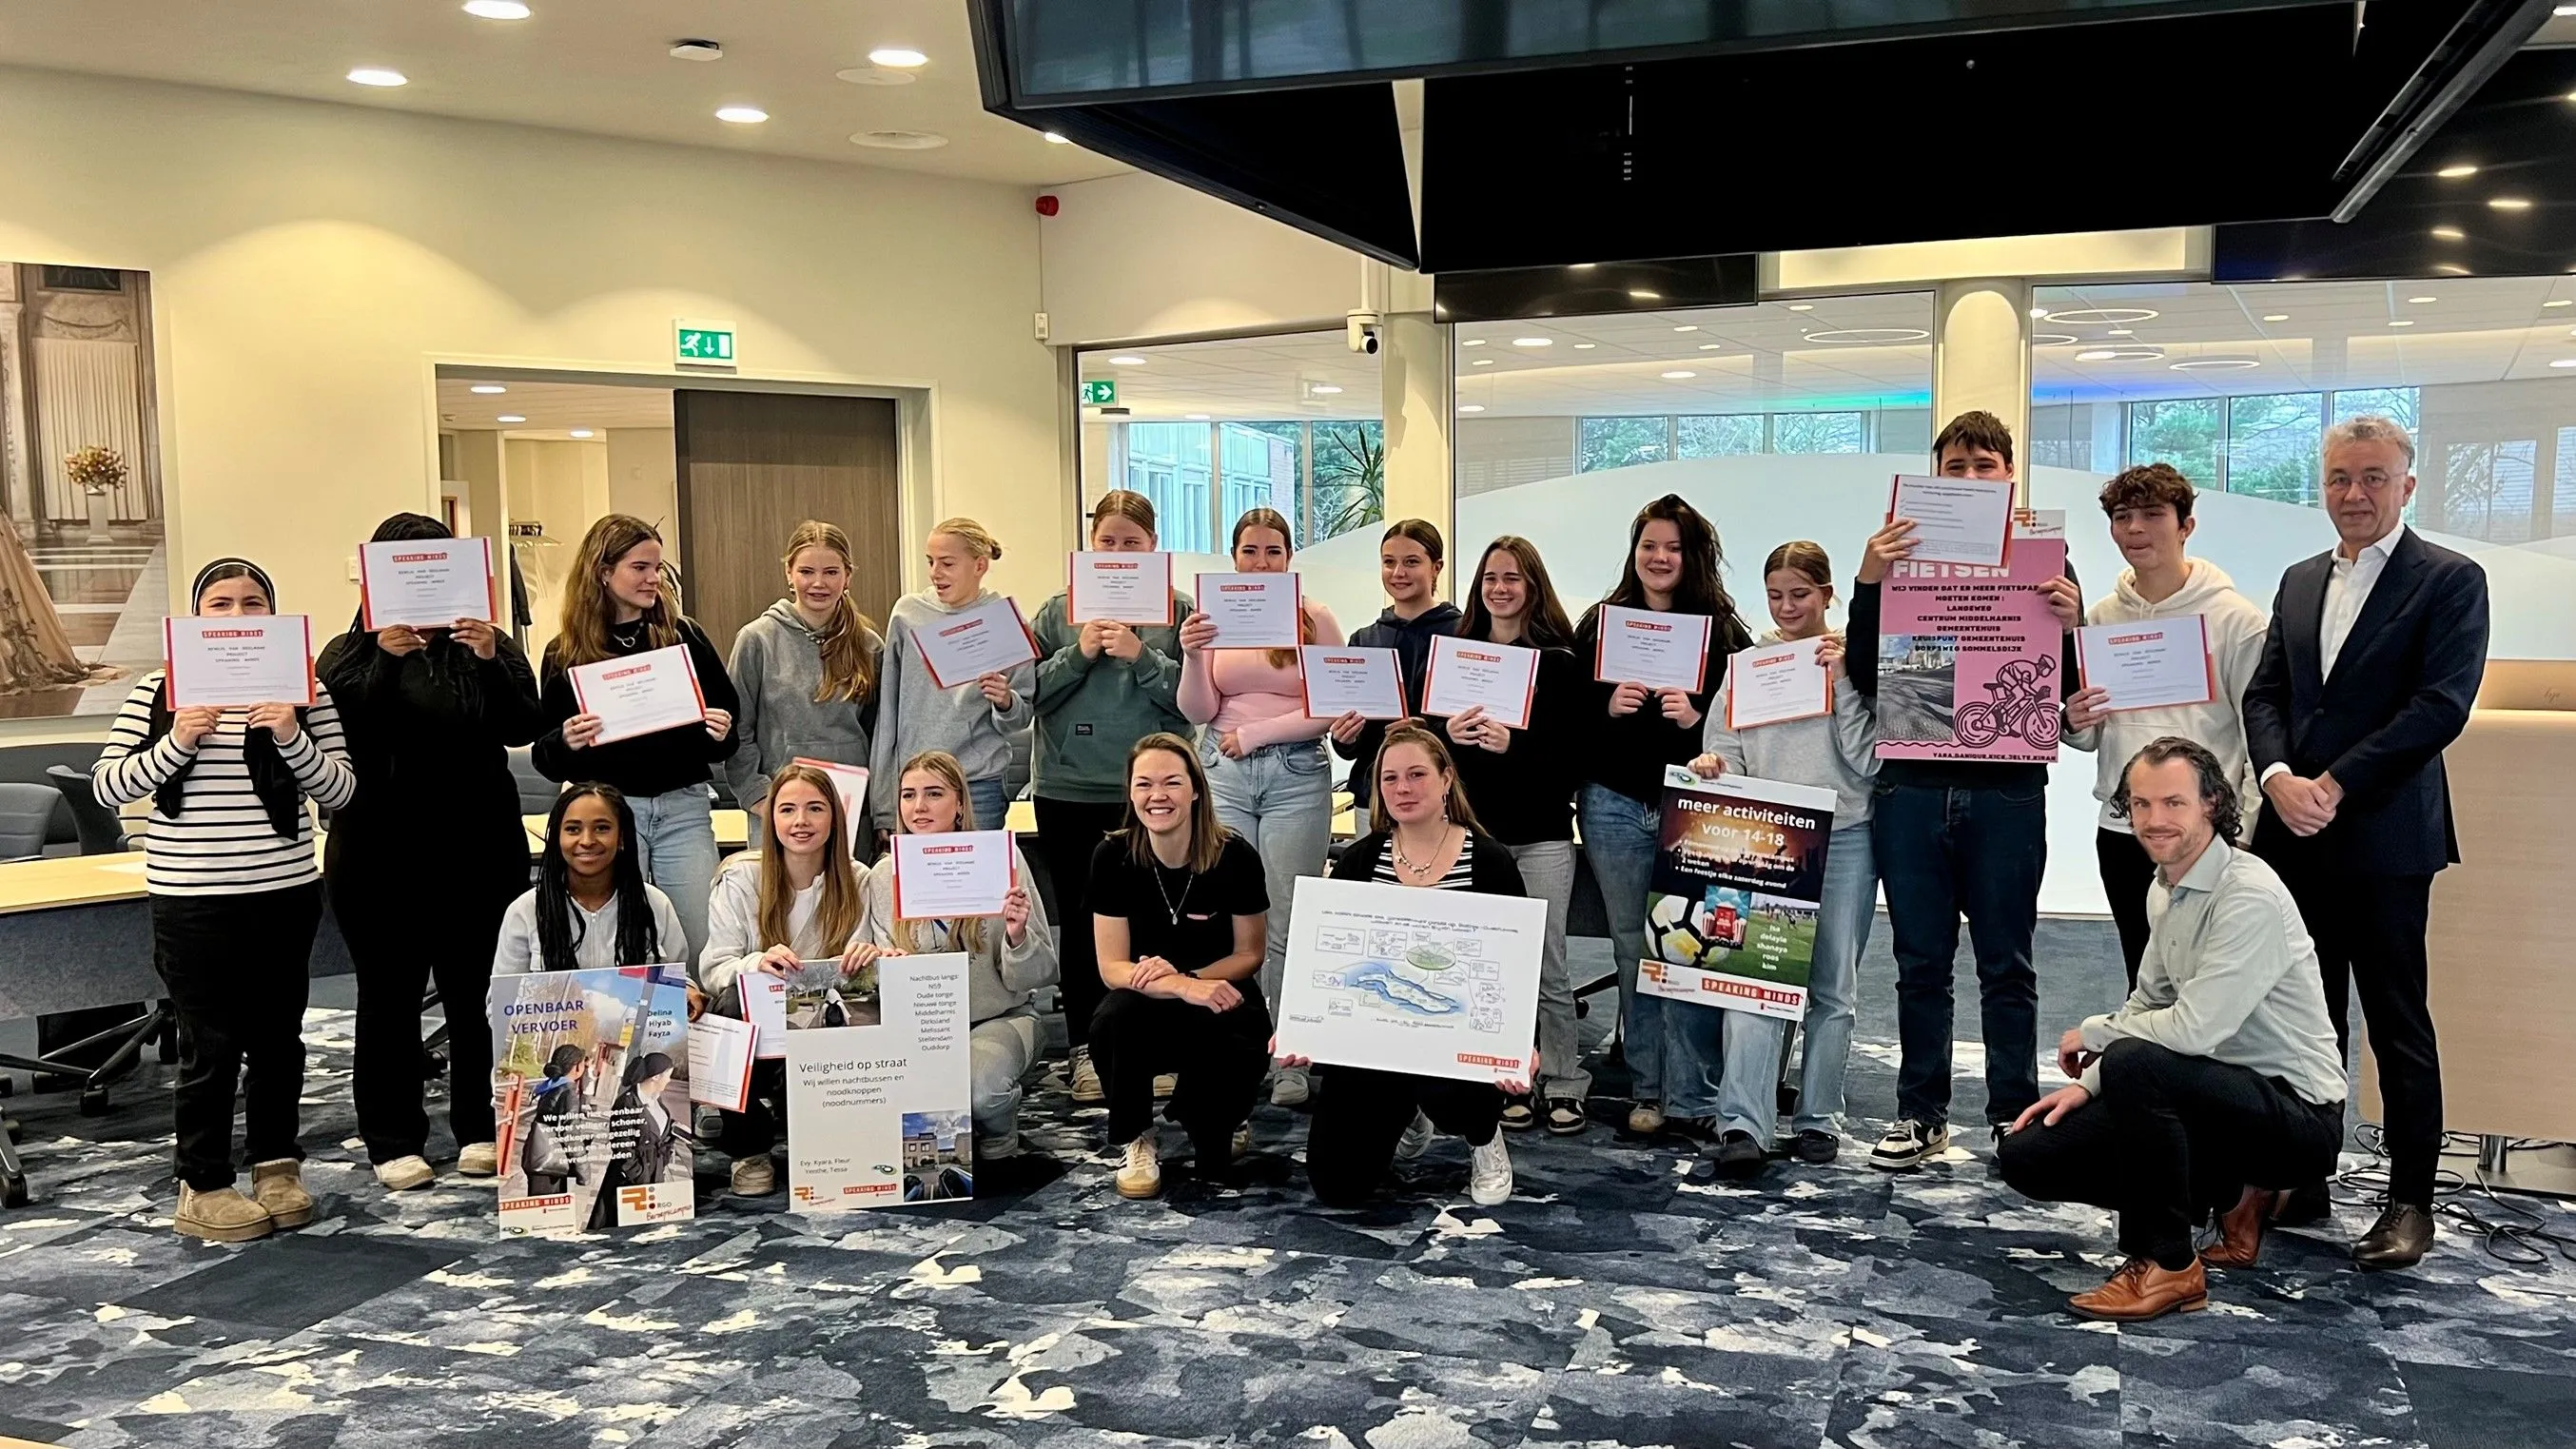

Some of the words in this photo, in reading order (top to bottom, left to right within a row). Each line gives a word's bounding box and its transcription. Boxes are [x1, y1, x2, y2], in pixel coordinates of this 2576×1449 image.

[1678, 798, 1720, 813] meer
[1723, 806, 1816, 830] activiteiten
[1702, 822, 1739, 838] voor
[1743, 829, 1785, 847] 14-18
[1694, 868, 1717, 878] feestje
[1762, 962, 1777, 970] kim
[1704, 978, 1758, 997] SPEAKING
[1763, 990, 1799, 1005] MINDS
[504, 1000, 584, 1016] OPENBAAR
[512, 1020, 578, 1034] VERVOER
[799, 1061, 854, 1074] Veiligheid
[857, 1062, 871, 1070] op
[875, 1059, 907, 1068] straat
[1457, 1054, 1493, 1066] SPEAKING
[803, 1079, 816, 1087] Wij
[842, 1075, 892, 1085] nachtbussen
[827, 1087, 882, 1096] noodknoppen
[822, 1097, 887, 1107] (noodnummers)
[549, 1134, 594, 1145] goedkoper
[609, 1129, 640, 1140] gezellig
[500, 1199, 539, 1211] SPEAKING
[543, 1195, 571, 1206] MINDS
